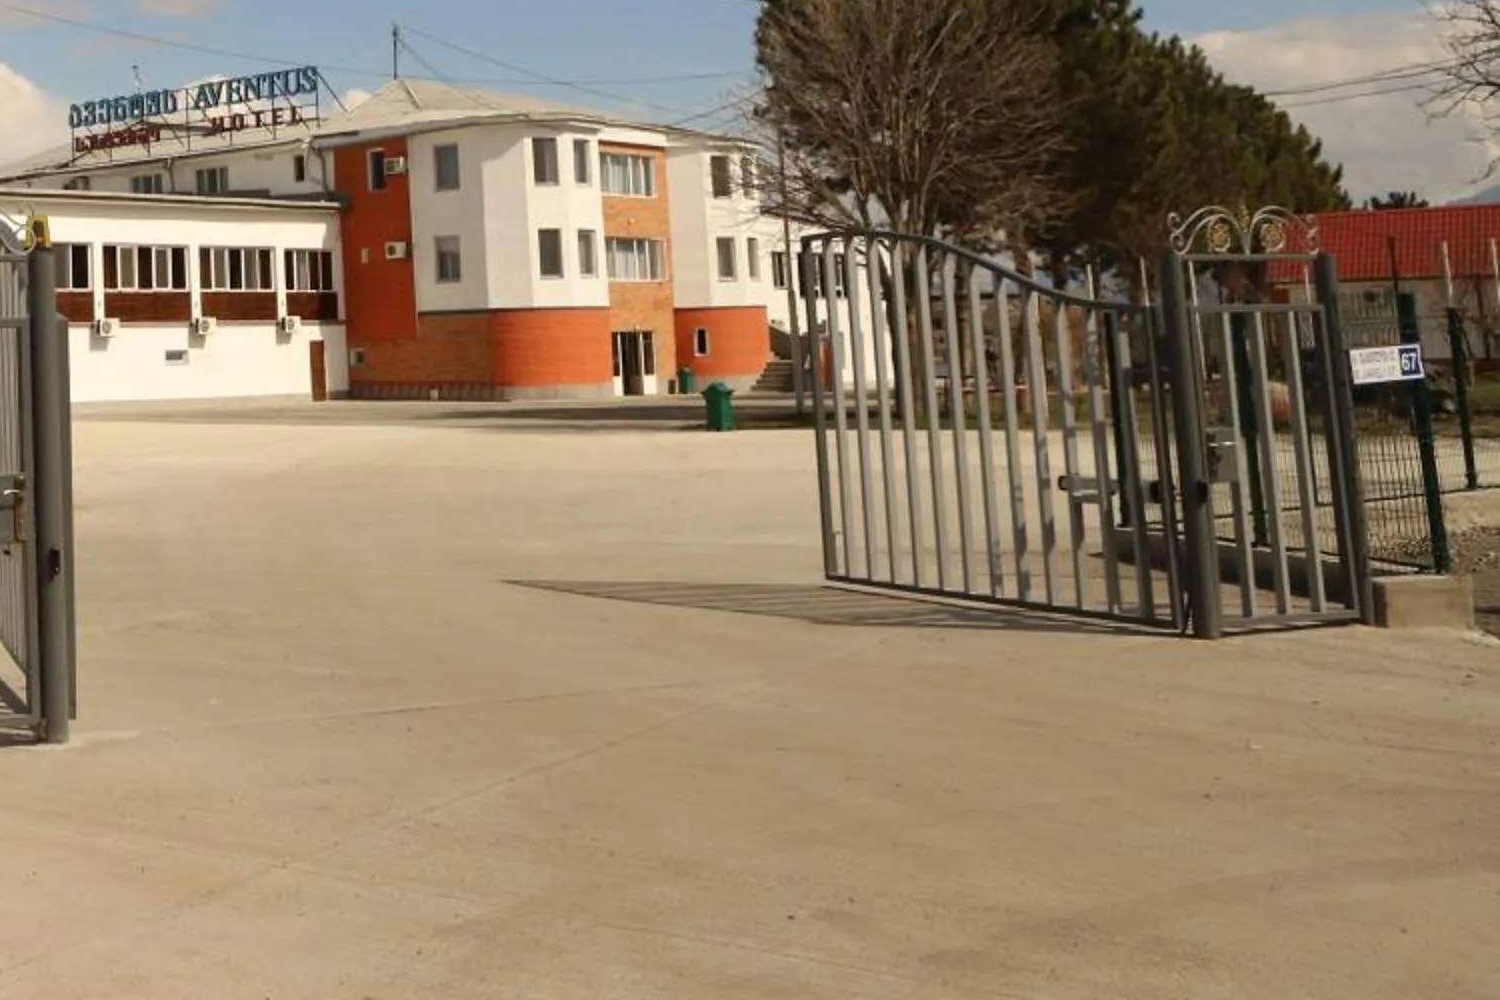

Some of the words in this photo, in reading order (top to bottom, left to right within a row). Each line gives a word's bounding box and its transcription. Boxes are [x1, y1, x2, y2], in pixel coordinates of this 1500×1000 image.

[192, 65, 318, 110] AVENTUS
[211, 105, 303, 132] HOTEL
[1401, 352, 1418, 371] 67
